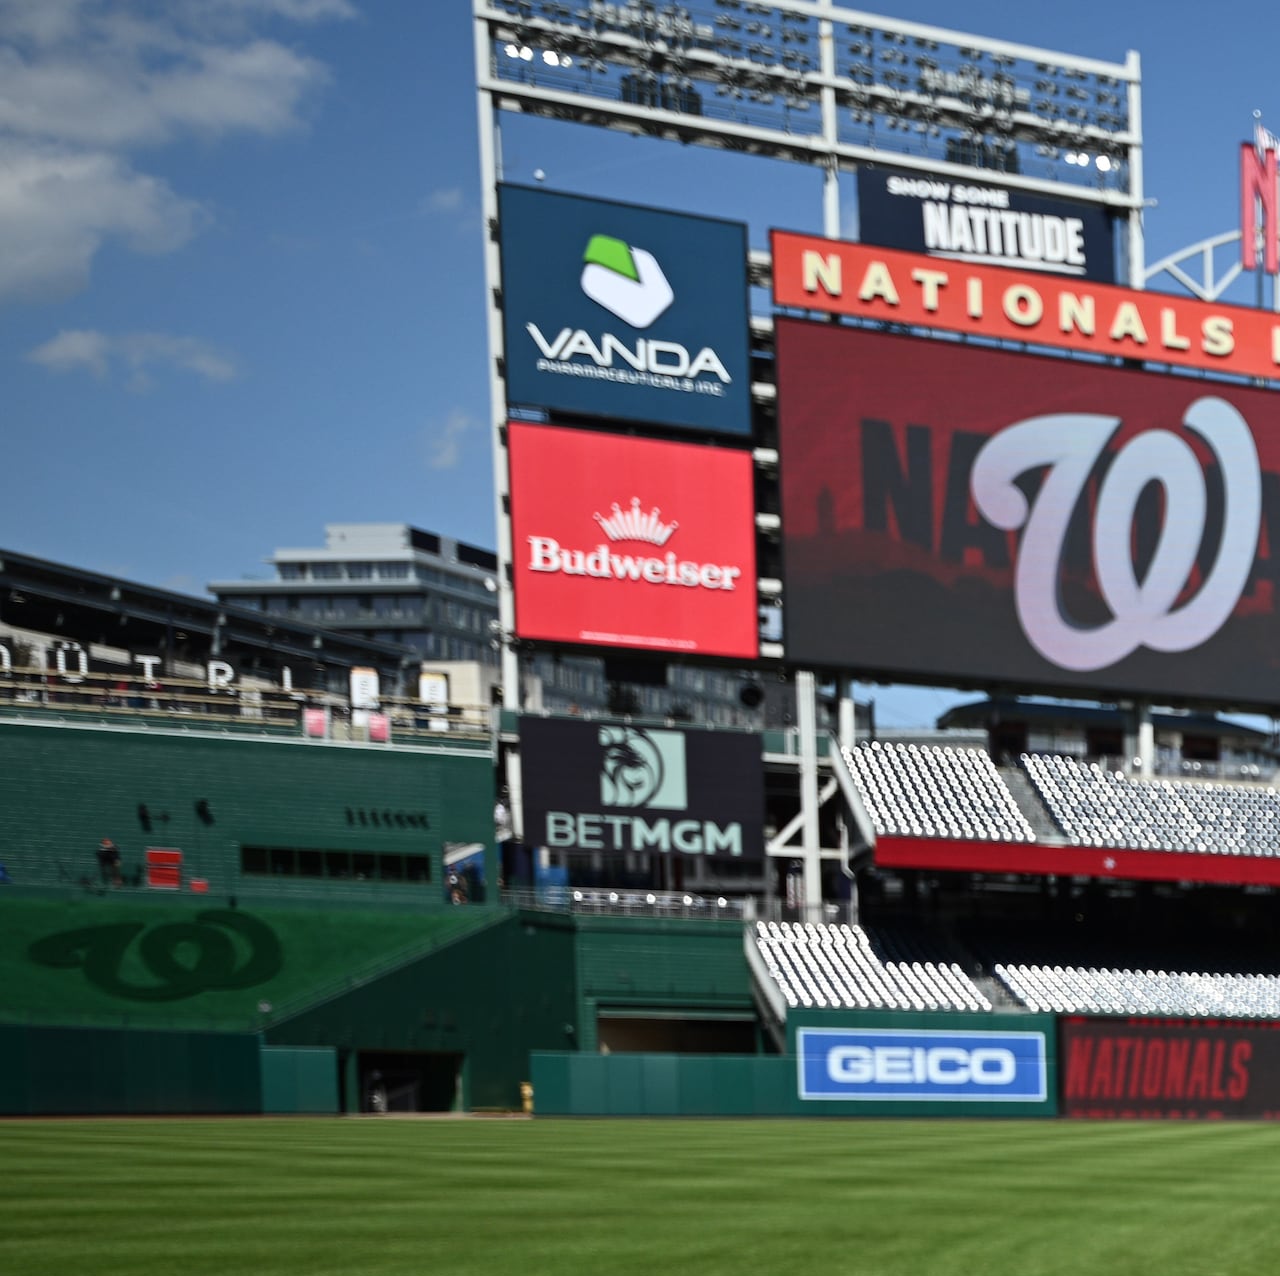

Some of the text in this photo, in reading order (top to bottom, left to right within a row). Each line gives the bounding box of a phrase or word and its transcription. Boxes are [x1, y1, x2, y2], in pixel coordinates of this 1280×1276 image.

[886, 175, 1010, 209] SHOW SOME
[922, 200, 1087, 266] NATITUDE
[802, 248, 1235, 358] NATIONALS
[526, 321, 733, 385] VANDA
[528, 535, 742, 591] Budweiser
[547, 811, 742, 857] BETMGM
[828, 1045, 1016, 1085] GEICO
[1065, 1036, 1252, 1100] NATIONALS
